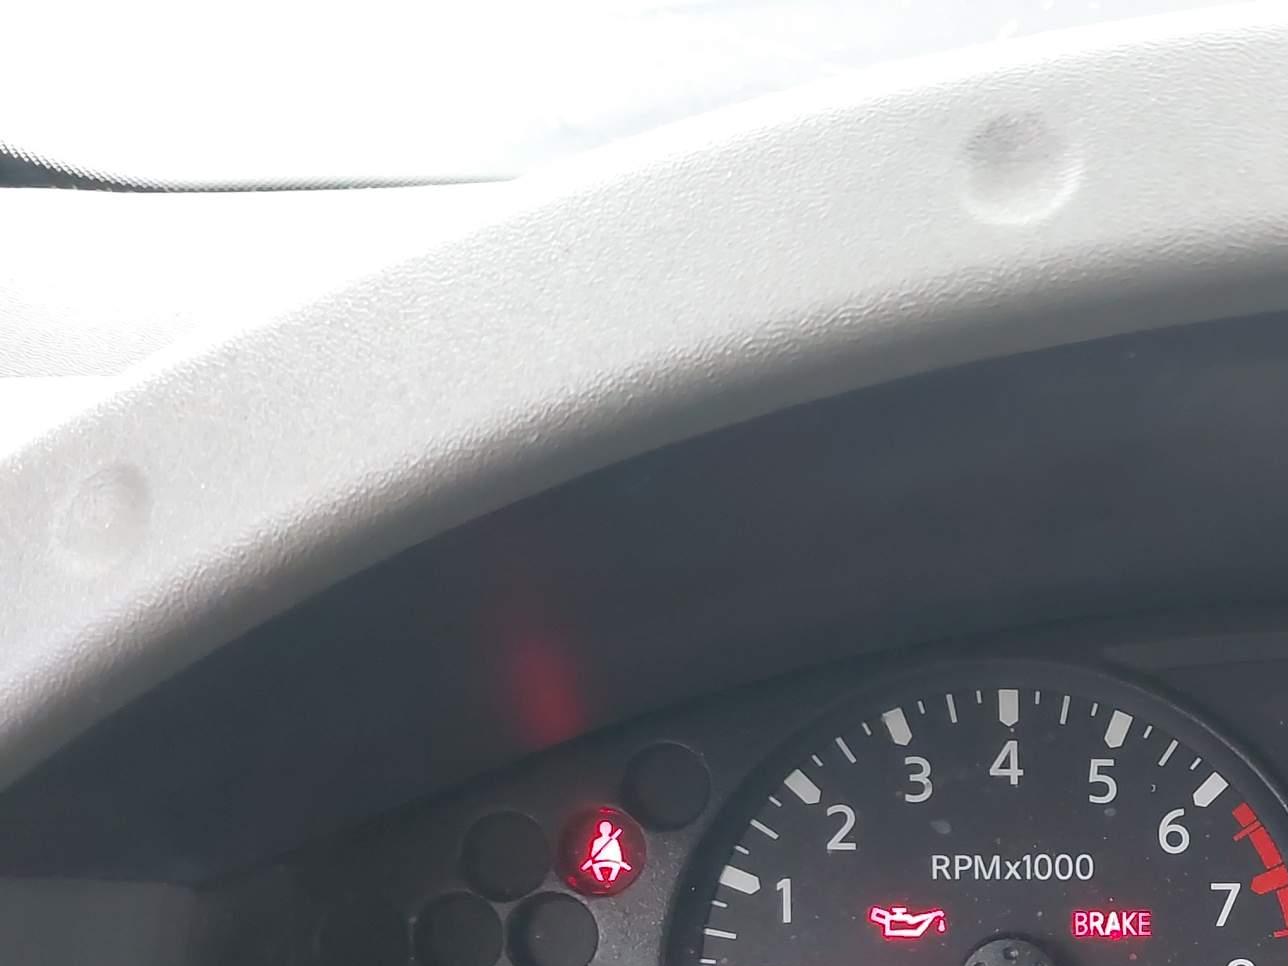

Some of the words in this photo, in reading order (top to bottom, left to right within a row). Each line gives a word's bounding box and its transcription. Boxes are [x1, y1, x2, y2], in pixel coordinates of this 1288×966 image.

[904, 756, 933, 803] 3
[989, 740, 1024, 785] 4
[1088, 758, 1117, 804] 5
[826, 804, 857, 851] 2
[1158, 808, 1190, 854] 6
[931, 853, 1094, 882] RPMx1000
[776, 878, 792, 923] 1
[1210, 882, 1241, 926] 7
[1074, 911, 1152, 936] BRAKE
